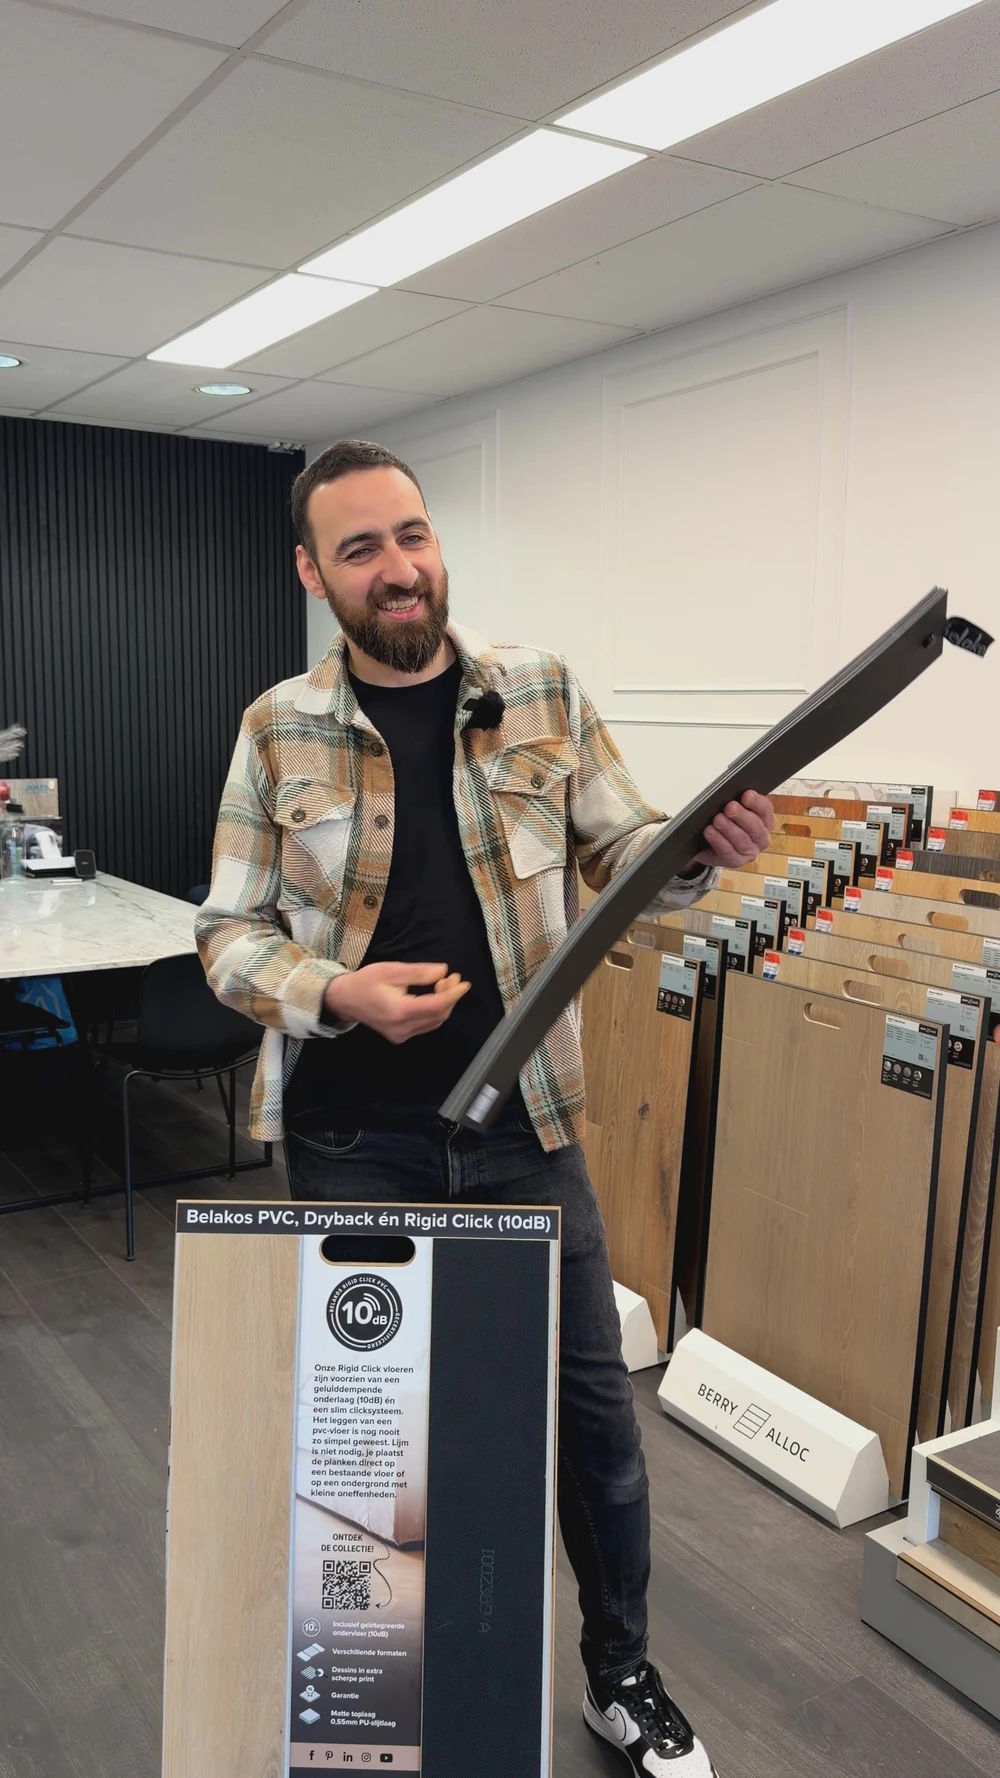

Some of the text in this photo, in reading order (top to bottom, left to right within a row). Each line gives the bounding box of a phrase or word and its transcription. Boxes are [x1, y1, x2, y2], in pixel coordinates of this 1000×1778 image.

[186, 1209, 551, 1233] Belakos PVC, Dryback én Rigid Click (10dB)
[329, 1288, 342, 1312] BELAKOS
[342, 1278, 357, 1289] RIGID
[377, 1280, 388, 1290] PVC
[342, 1301, 387, 1325] 10 dB
[338, 1365, 358, 1373] Rigid
[314, 1375, 328, 1383] zijn
[314, 1386, 382, 1394] geluiddempende
[314, 1396, 354, 1405] onderlaag
[357, 1396, 382, 1405] (10dB)
[349, 1407, 403, 1415] clicksysteem.
[330, 1417, 357, 1425] leggen
[698, 1384, 809, 1462] BERRY ALLOC
[313, 1427, 350, 1435] pvc-vloer
[324, 1438, 350, 1446] simpel
[392, 1439, 408, 1447] Lijm
[339, 1449, 364, 1457] nodig,
[366, 1449, 373, 1457] je
[341, 1480, 389, 1488] ondergrond
[338, 1490, 397, 1498] oneffenheden.
